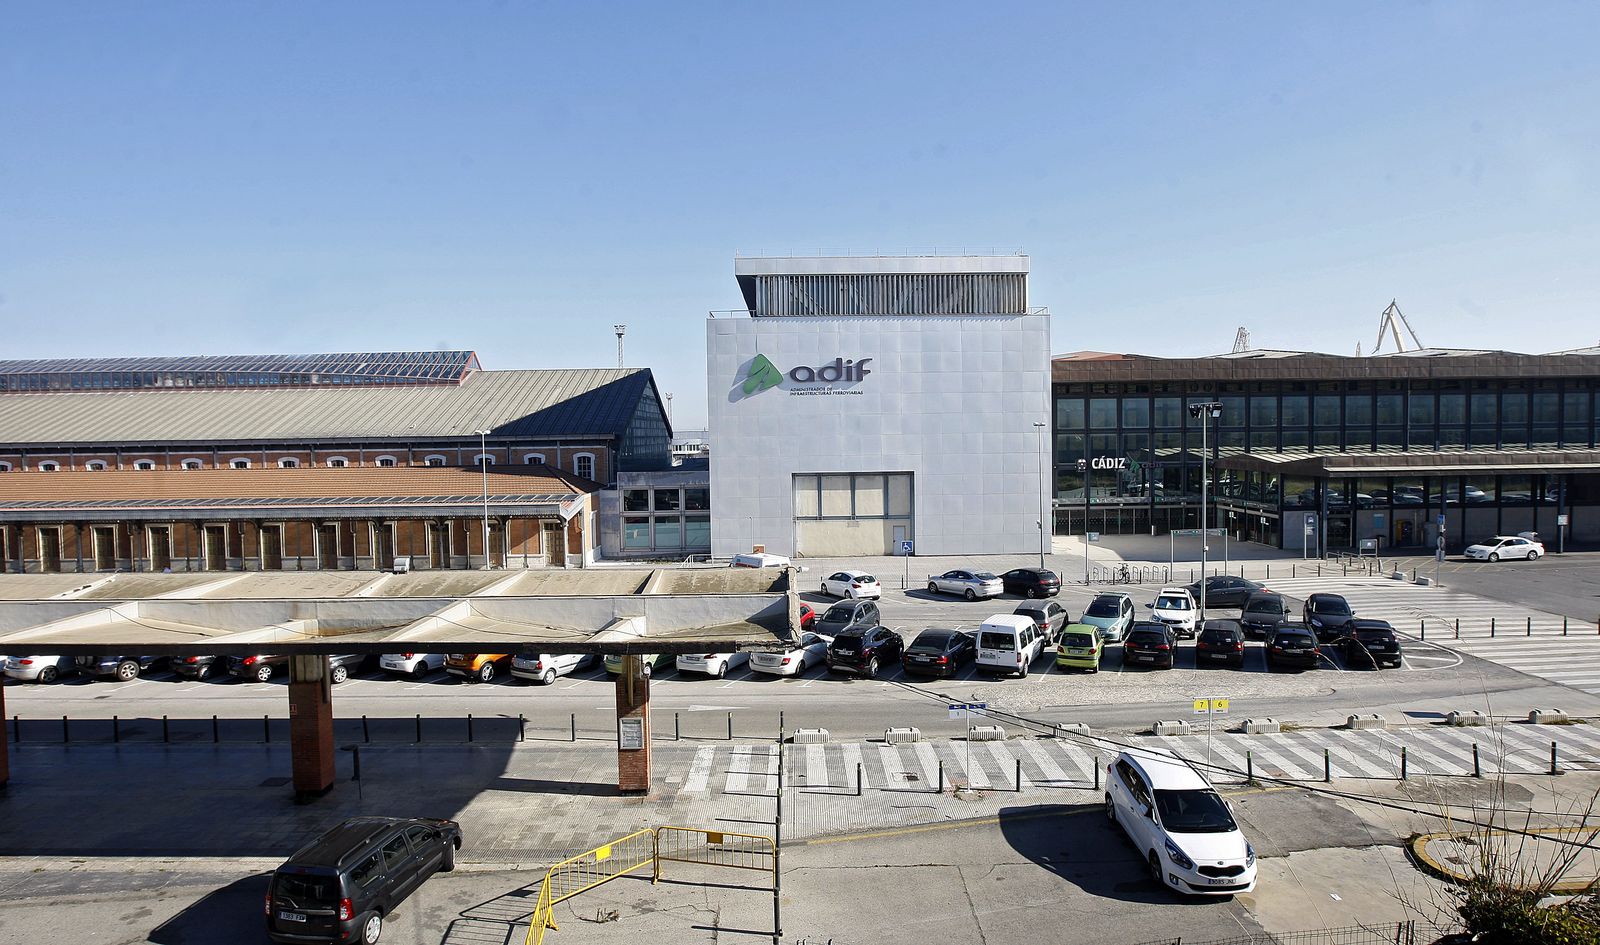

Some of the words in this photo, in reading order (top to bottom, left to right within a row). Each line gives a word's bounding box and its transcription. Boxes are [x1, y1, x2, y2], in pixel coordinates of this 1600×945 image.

[790, 357, 873, 382] adif
[1091, 455, 1126, 469] CÁDIZ
[1217, 700, 1223, 708] 6
